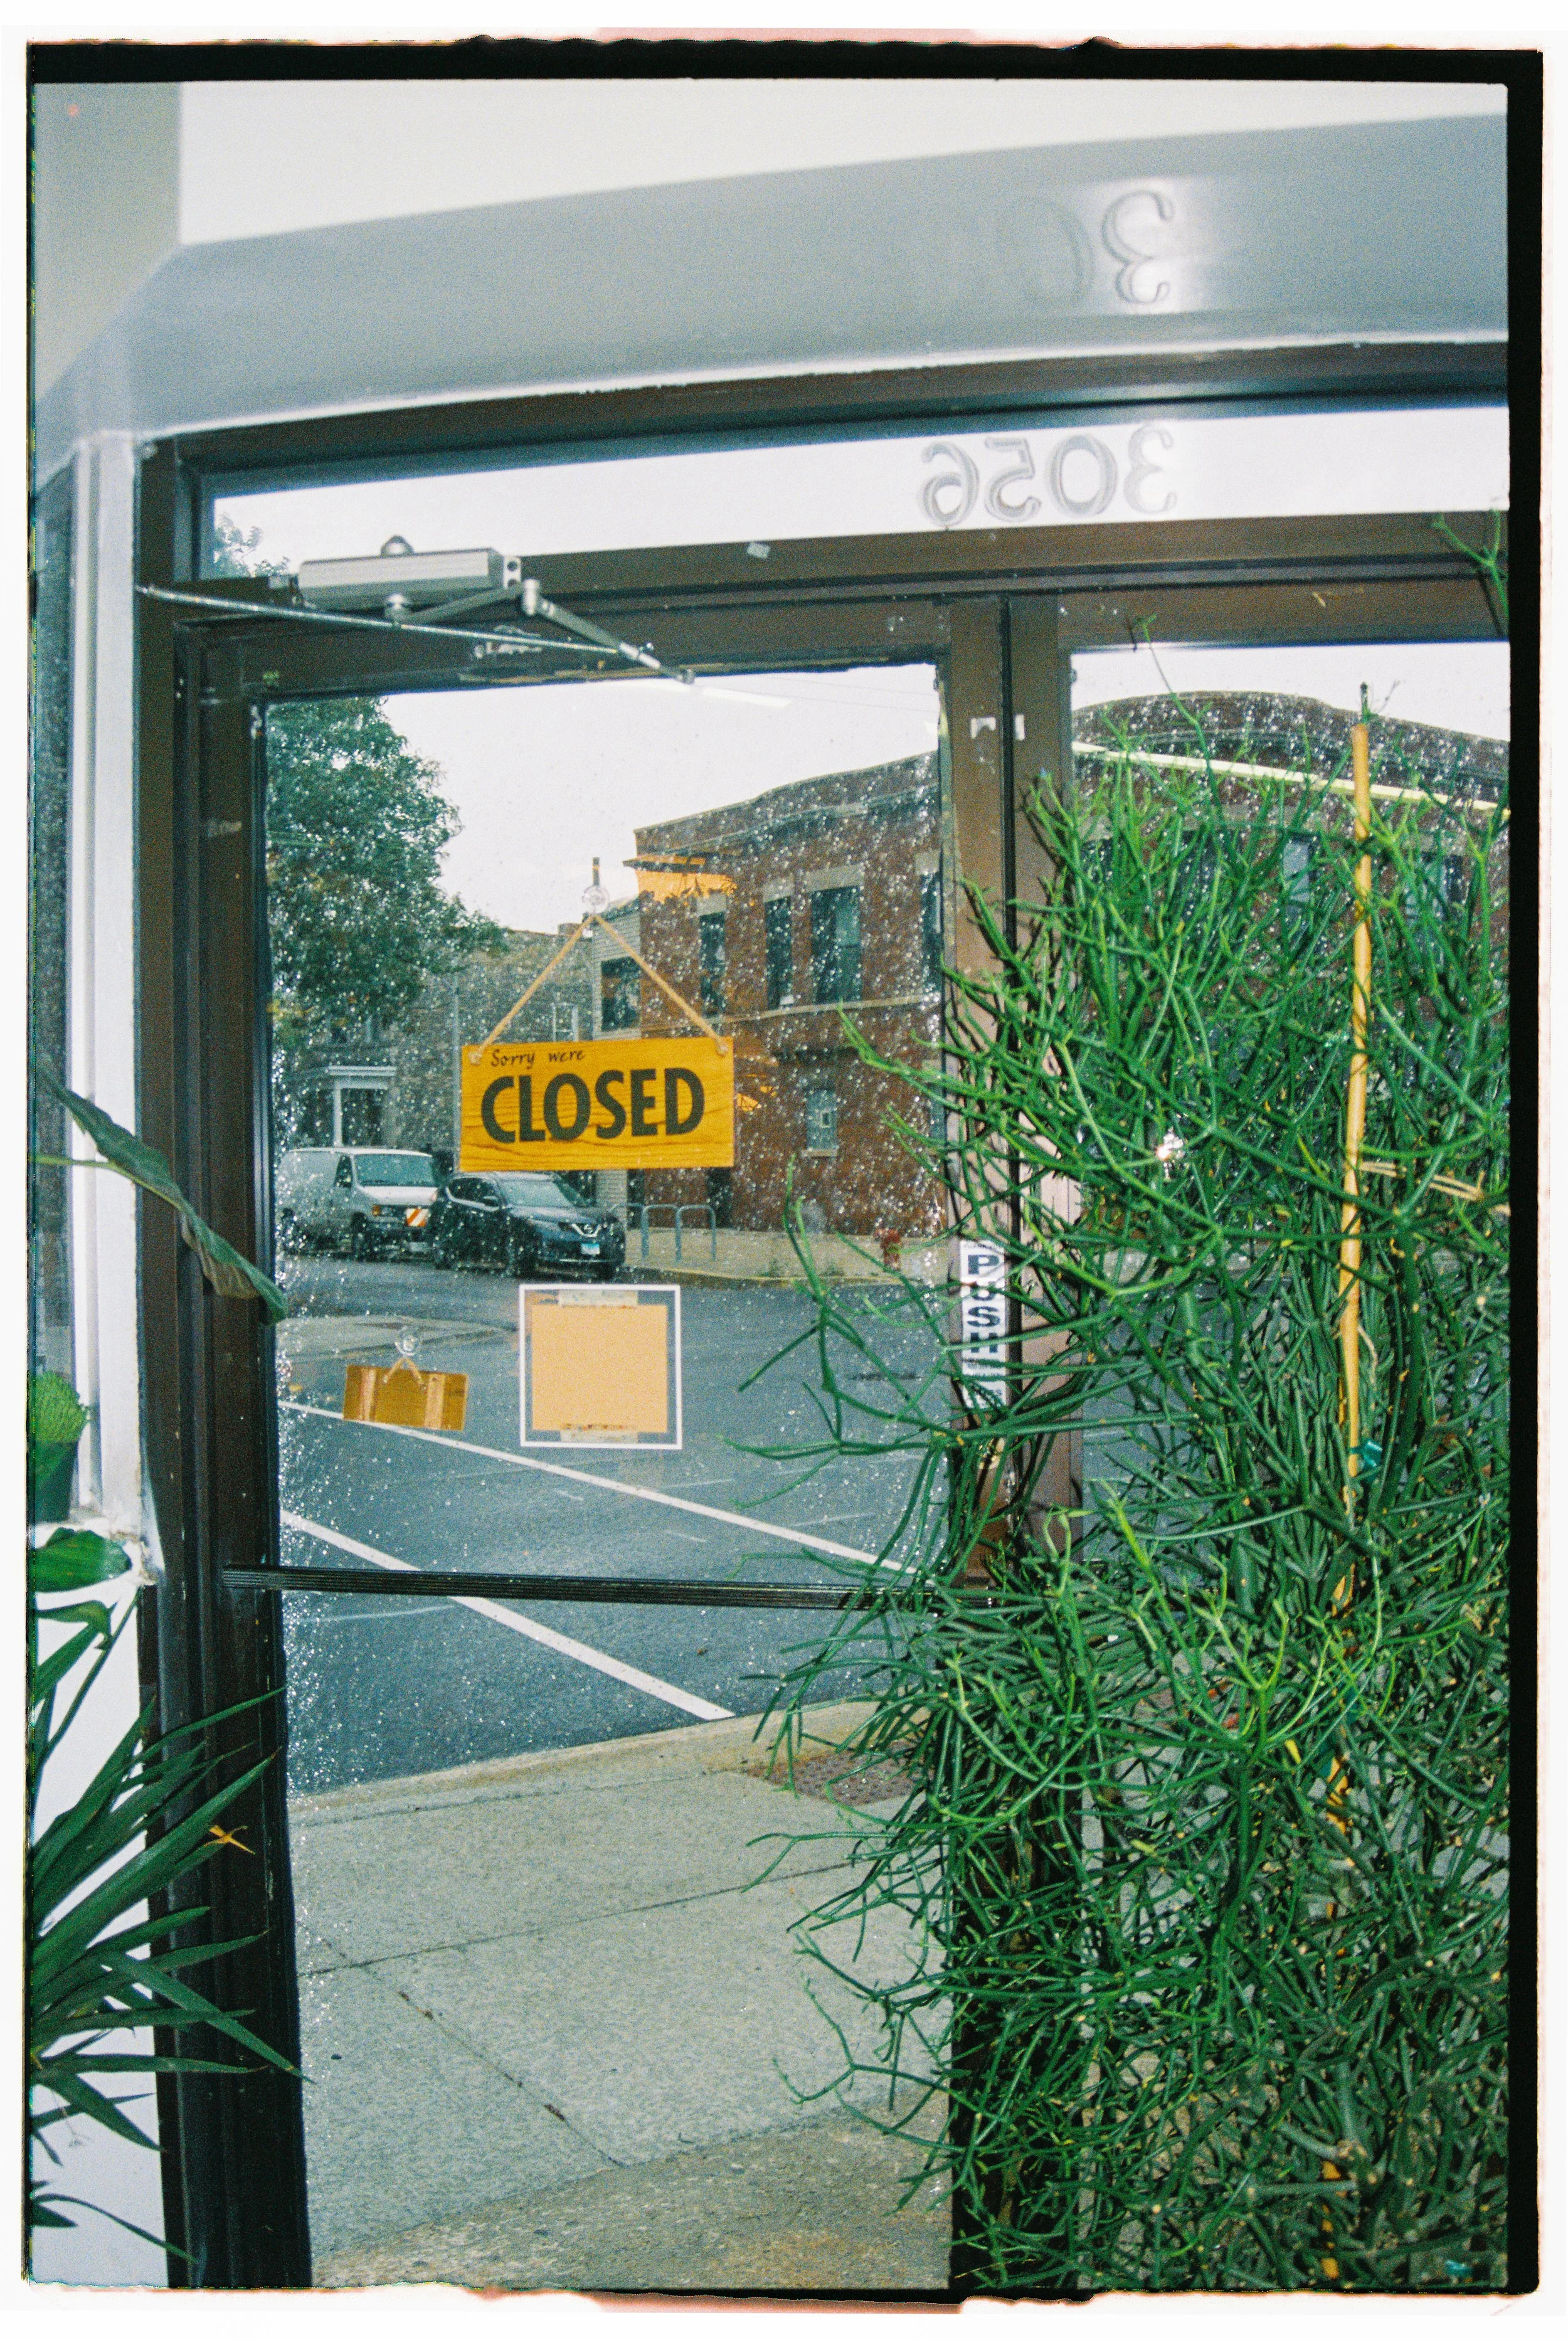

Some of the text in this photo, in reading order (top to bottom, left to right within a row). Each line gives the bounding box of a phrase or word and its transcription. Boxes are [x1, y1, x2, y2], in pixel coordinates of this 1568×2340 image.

[490, 1049, 586, 1070] Sorry were
[480, 1067, 705, 1143] CLOSED
